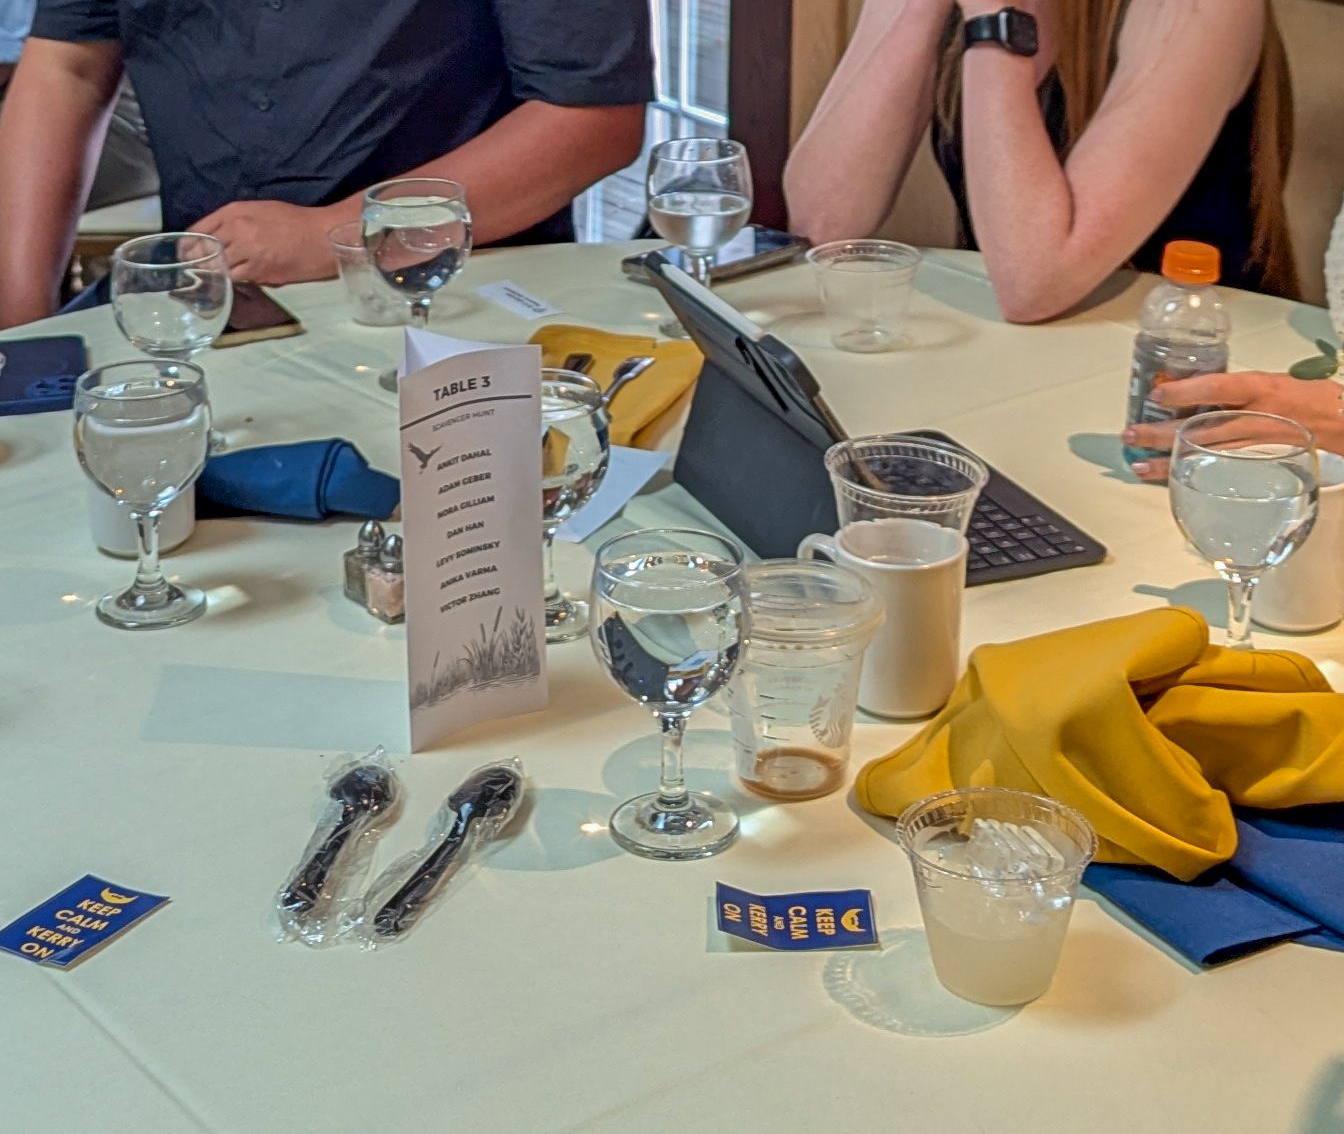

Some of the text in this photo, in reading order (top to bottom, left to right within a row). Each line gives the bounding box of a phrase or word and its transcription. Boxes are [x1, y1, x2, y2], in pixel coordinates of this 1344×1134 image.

[433, 376, 491, 401] TABLE 3
[432, 409, 495, 432] SCAVENGER HUNT
[437, 449, 492, 471] ANKIT DAHAL
[438, 480, 461, 494] ADAM
[437, 495, 495, 519] NORA GILLIAM
[447, 520, 485, 539] DAN HAN
[436, 540, 501, 568] LEVY SOMINSKY
[440, 565, 498, 589] ANIKA VARMA
[440, 587, 501, 613] VICTOR ZHANG
[76, 898, 123, 917] KEEP
[723, 902, 742, 923] ON
[54, 909, 109, 931] CALM
[56, 923, 81, 935] AND
[749, 903, 769, 937] KERRY
[788, 905, 809, 940] CALM
[815, 908, 836, 936] KEEP
[26, 925, 85, 949] KERRY
[20, 942, 55, 959] ON
